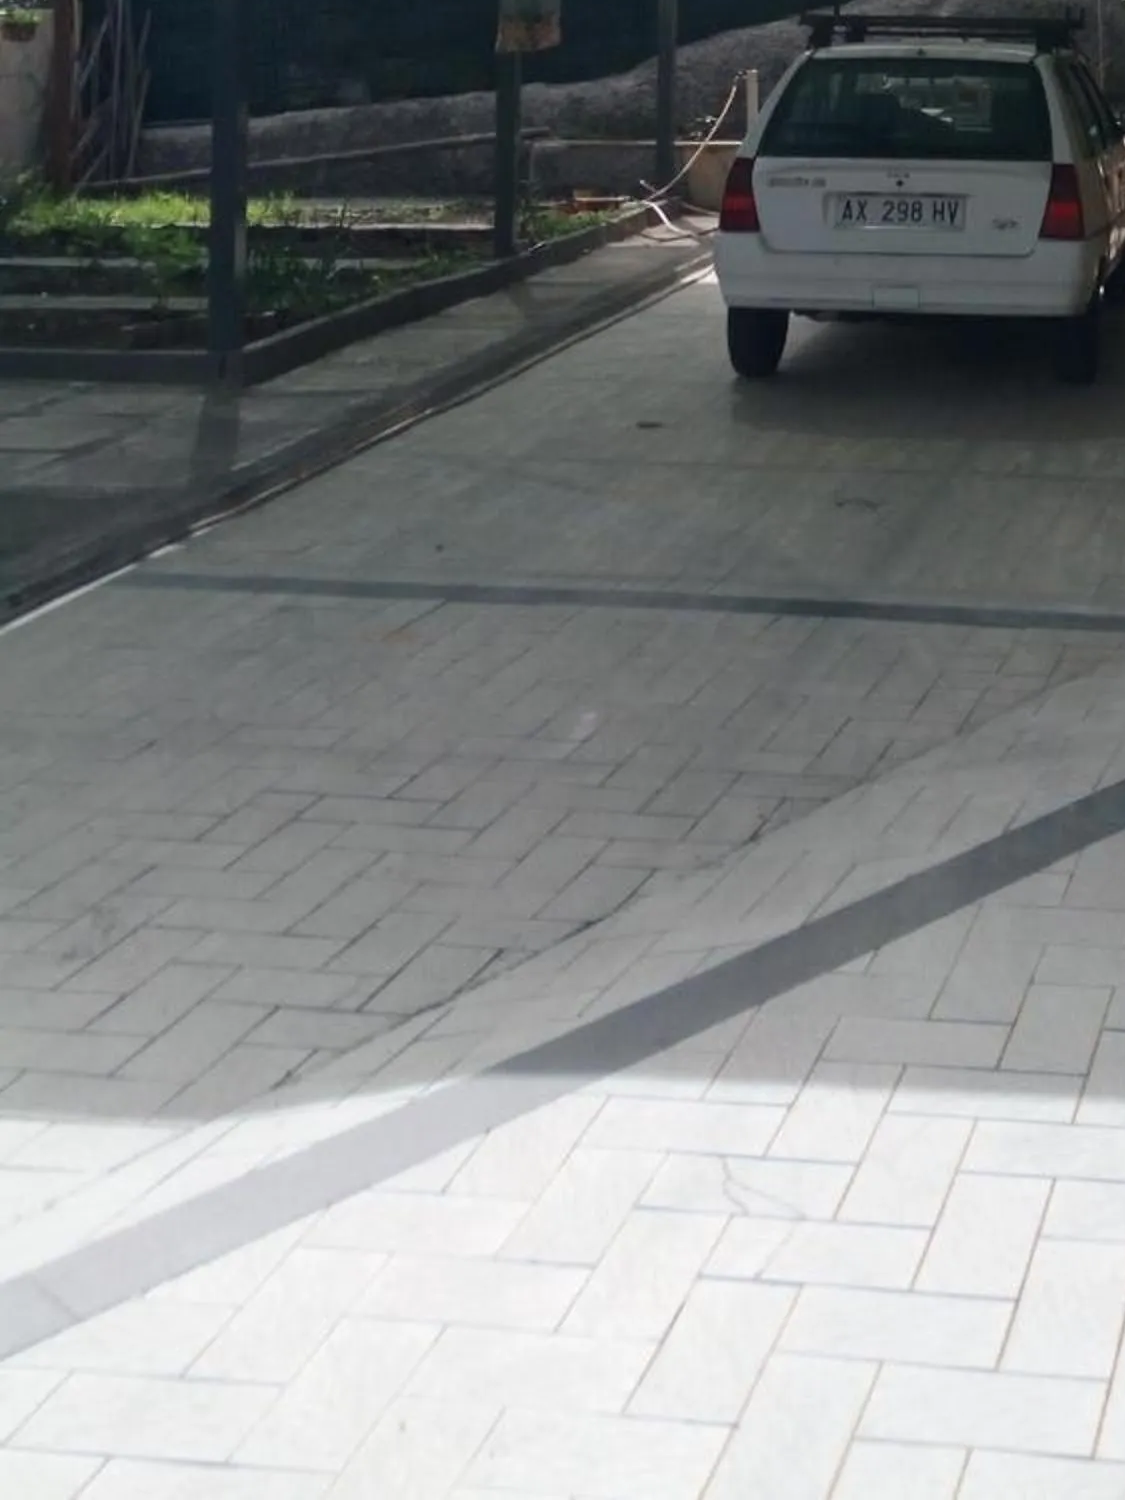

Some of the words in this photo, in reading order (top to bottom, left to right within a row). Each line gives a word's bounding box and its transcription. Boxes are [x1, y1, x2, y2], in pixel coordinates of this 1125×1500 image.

[842, 199, 868, 221] AX
[881, 199, 923, 222] 298
[933, 200, 959, 225] HV
